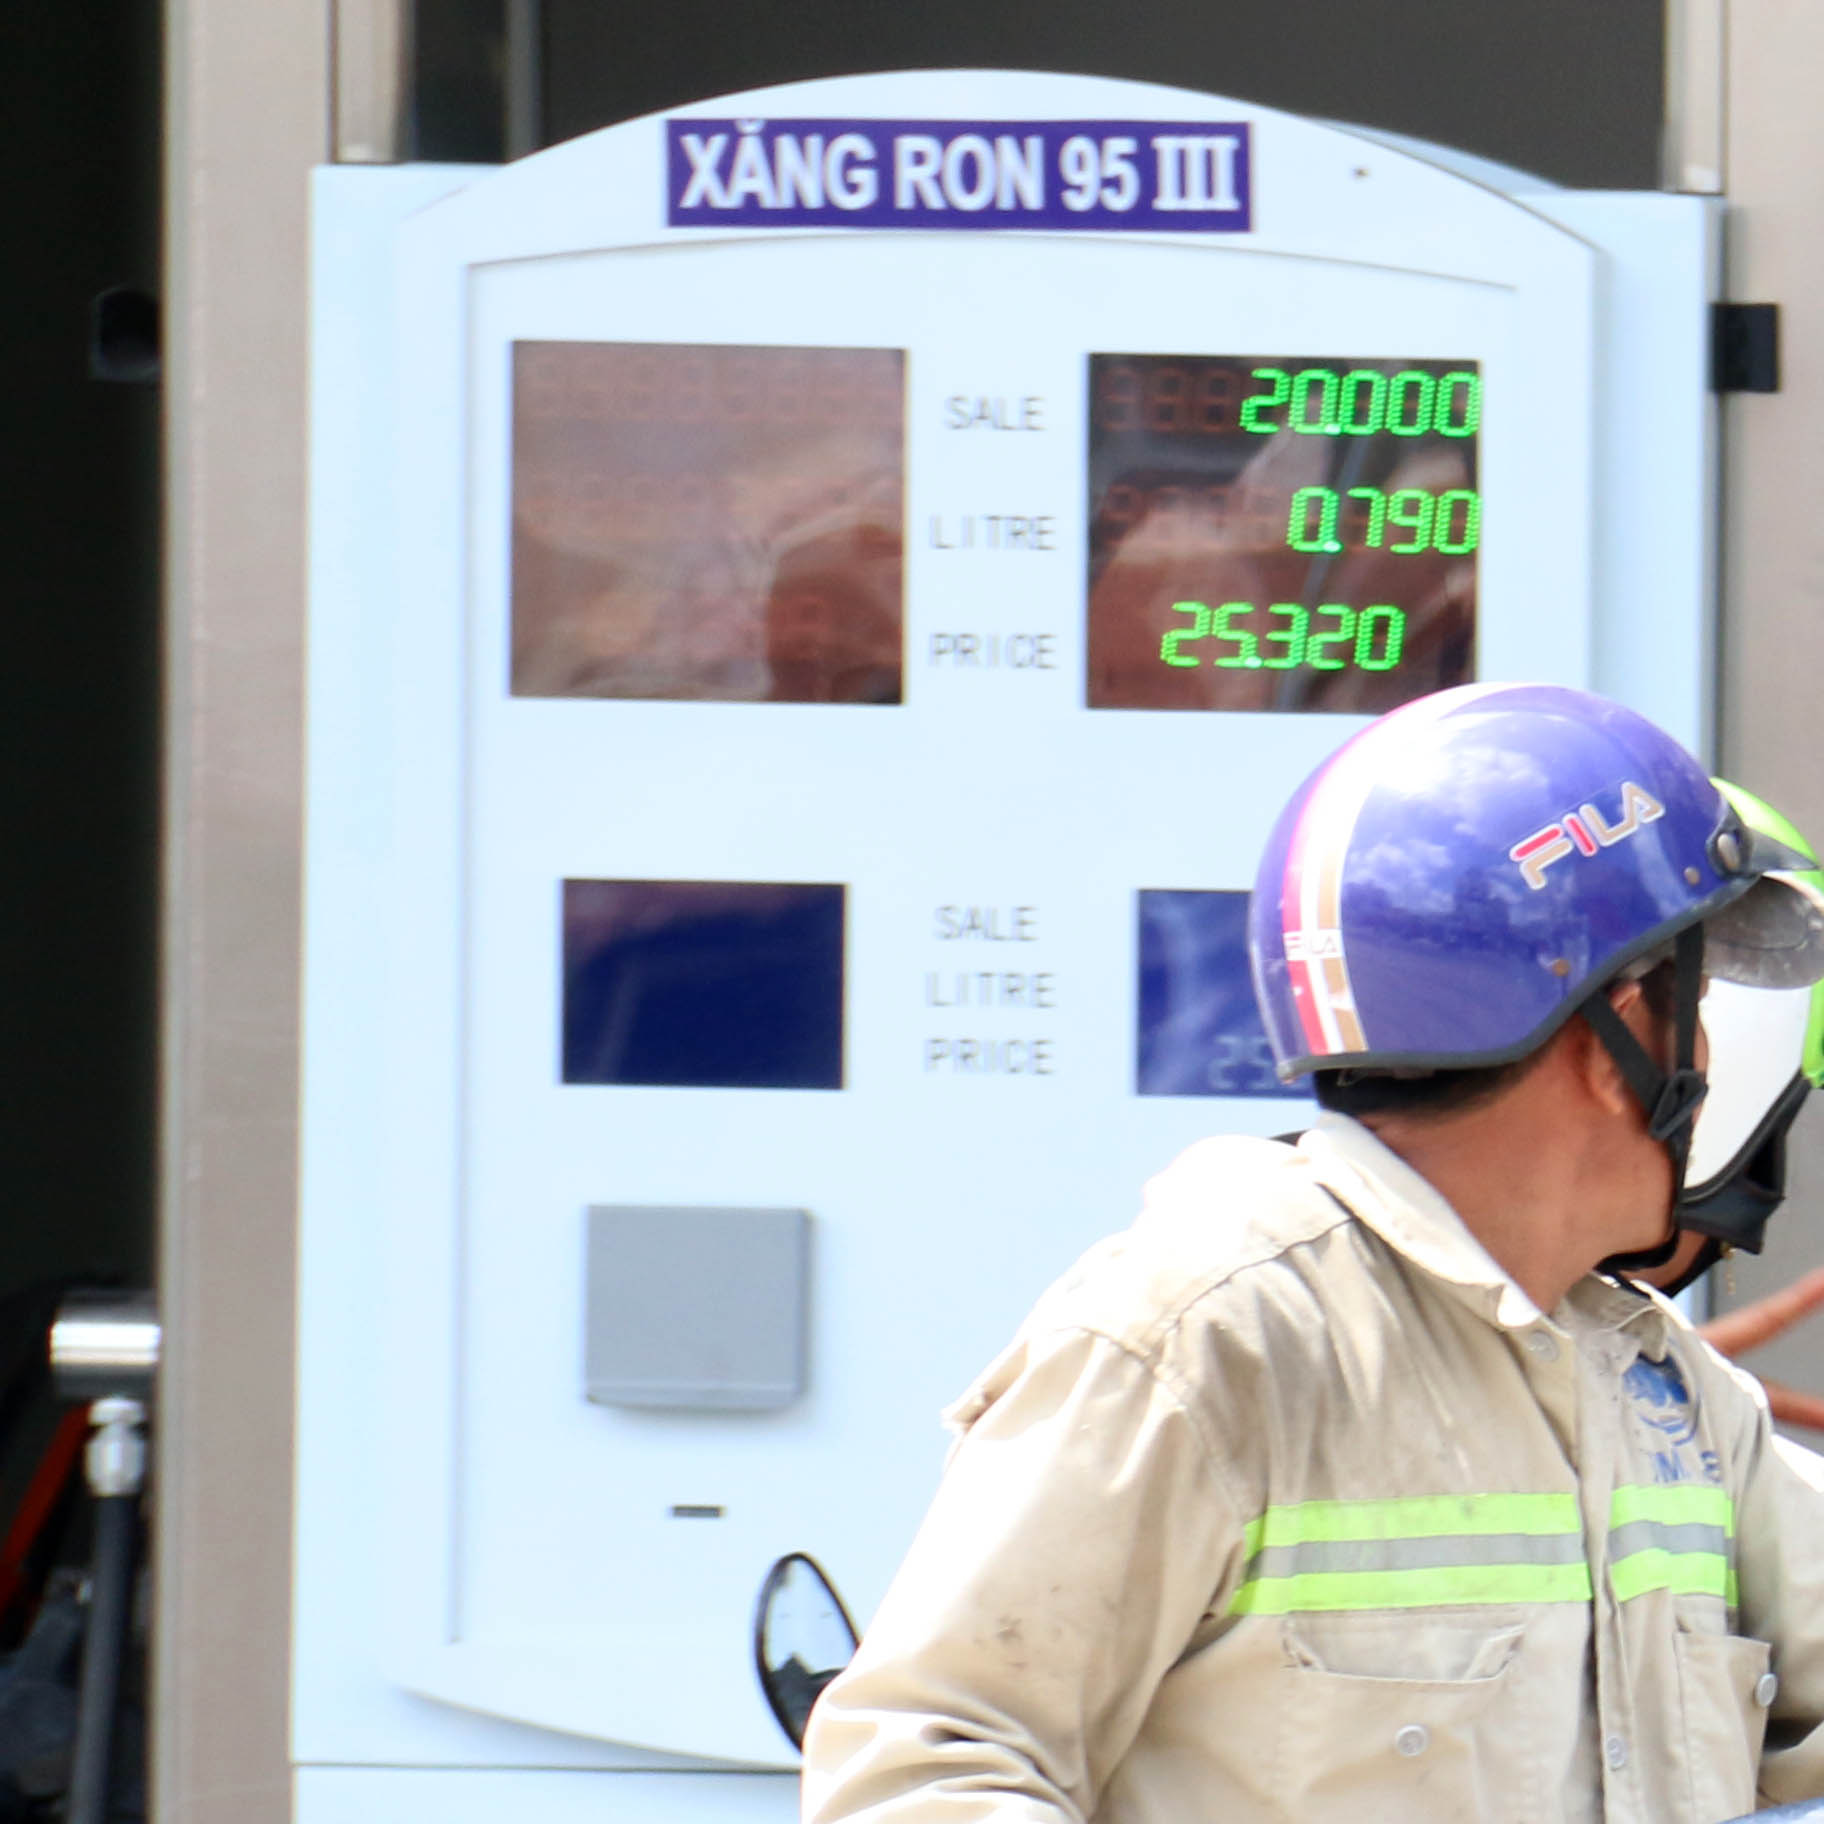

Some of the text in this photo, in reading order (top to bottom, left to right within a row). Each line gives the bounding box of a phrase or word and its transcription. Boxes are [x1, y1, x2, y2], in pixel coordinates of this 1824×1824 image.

[679, 118, 1241, 211] XĂNG RON 95 III
[947, 395, 1045, 433] SALE
[1239, 367, 1483, 437] 20.000
[930, 514, 1057, 552] LITRE
[1287, 486, 1483, 555] 0.790
[930, 632, 1057, 671] PRICE
[1161, 601, 1406, 671] 25.320
[1509, 781, 1665, 890] FILA
[937, 904, 1038, 943] SALE
[930, 971, 1057, 1009] LITRE
[929, 1037, 1054, 1076] PRICE
